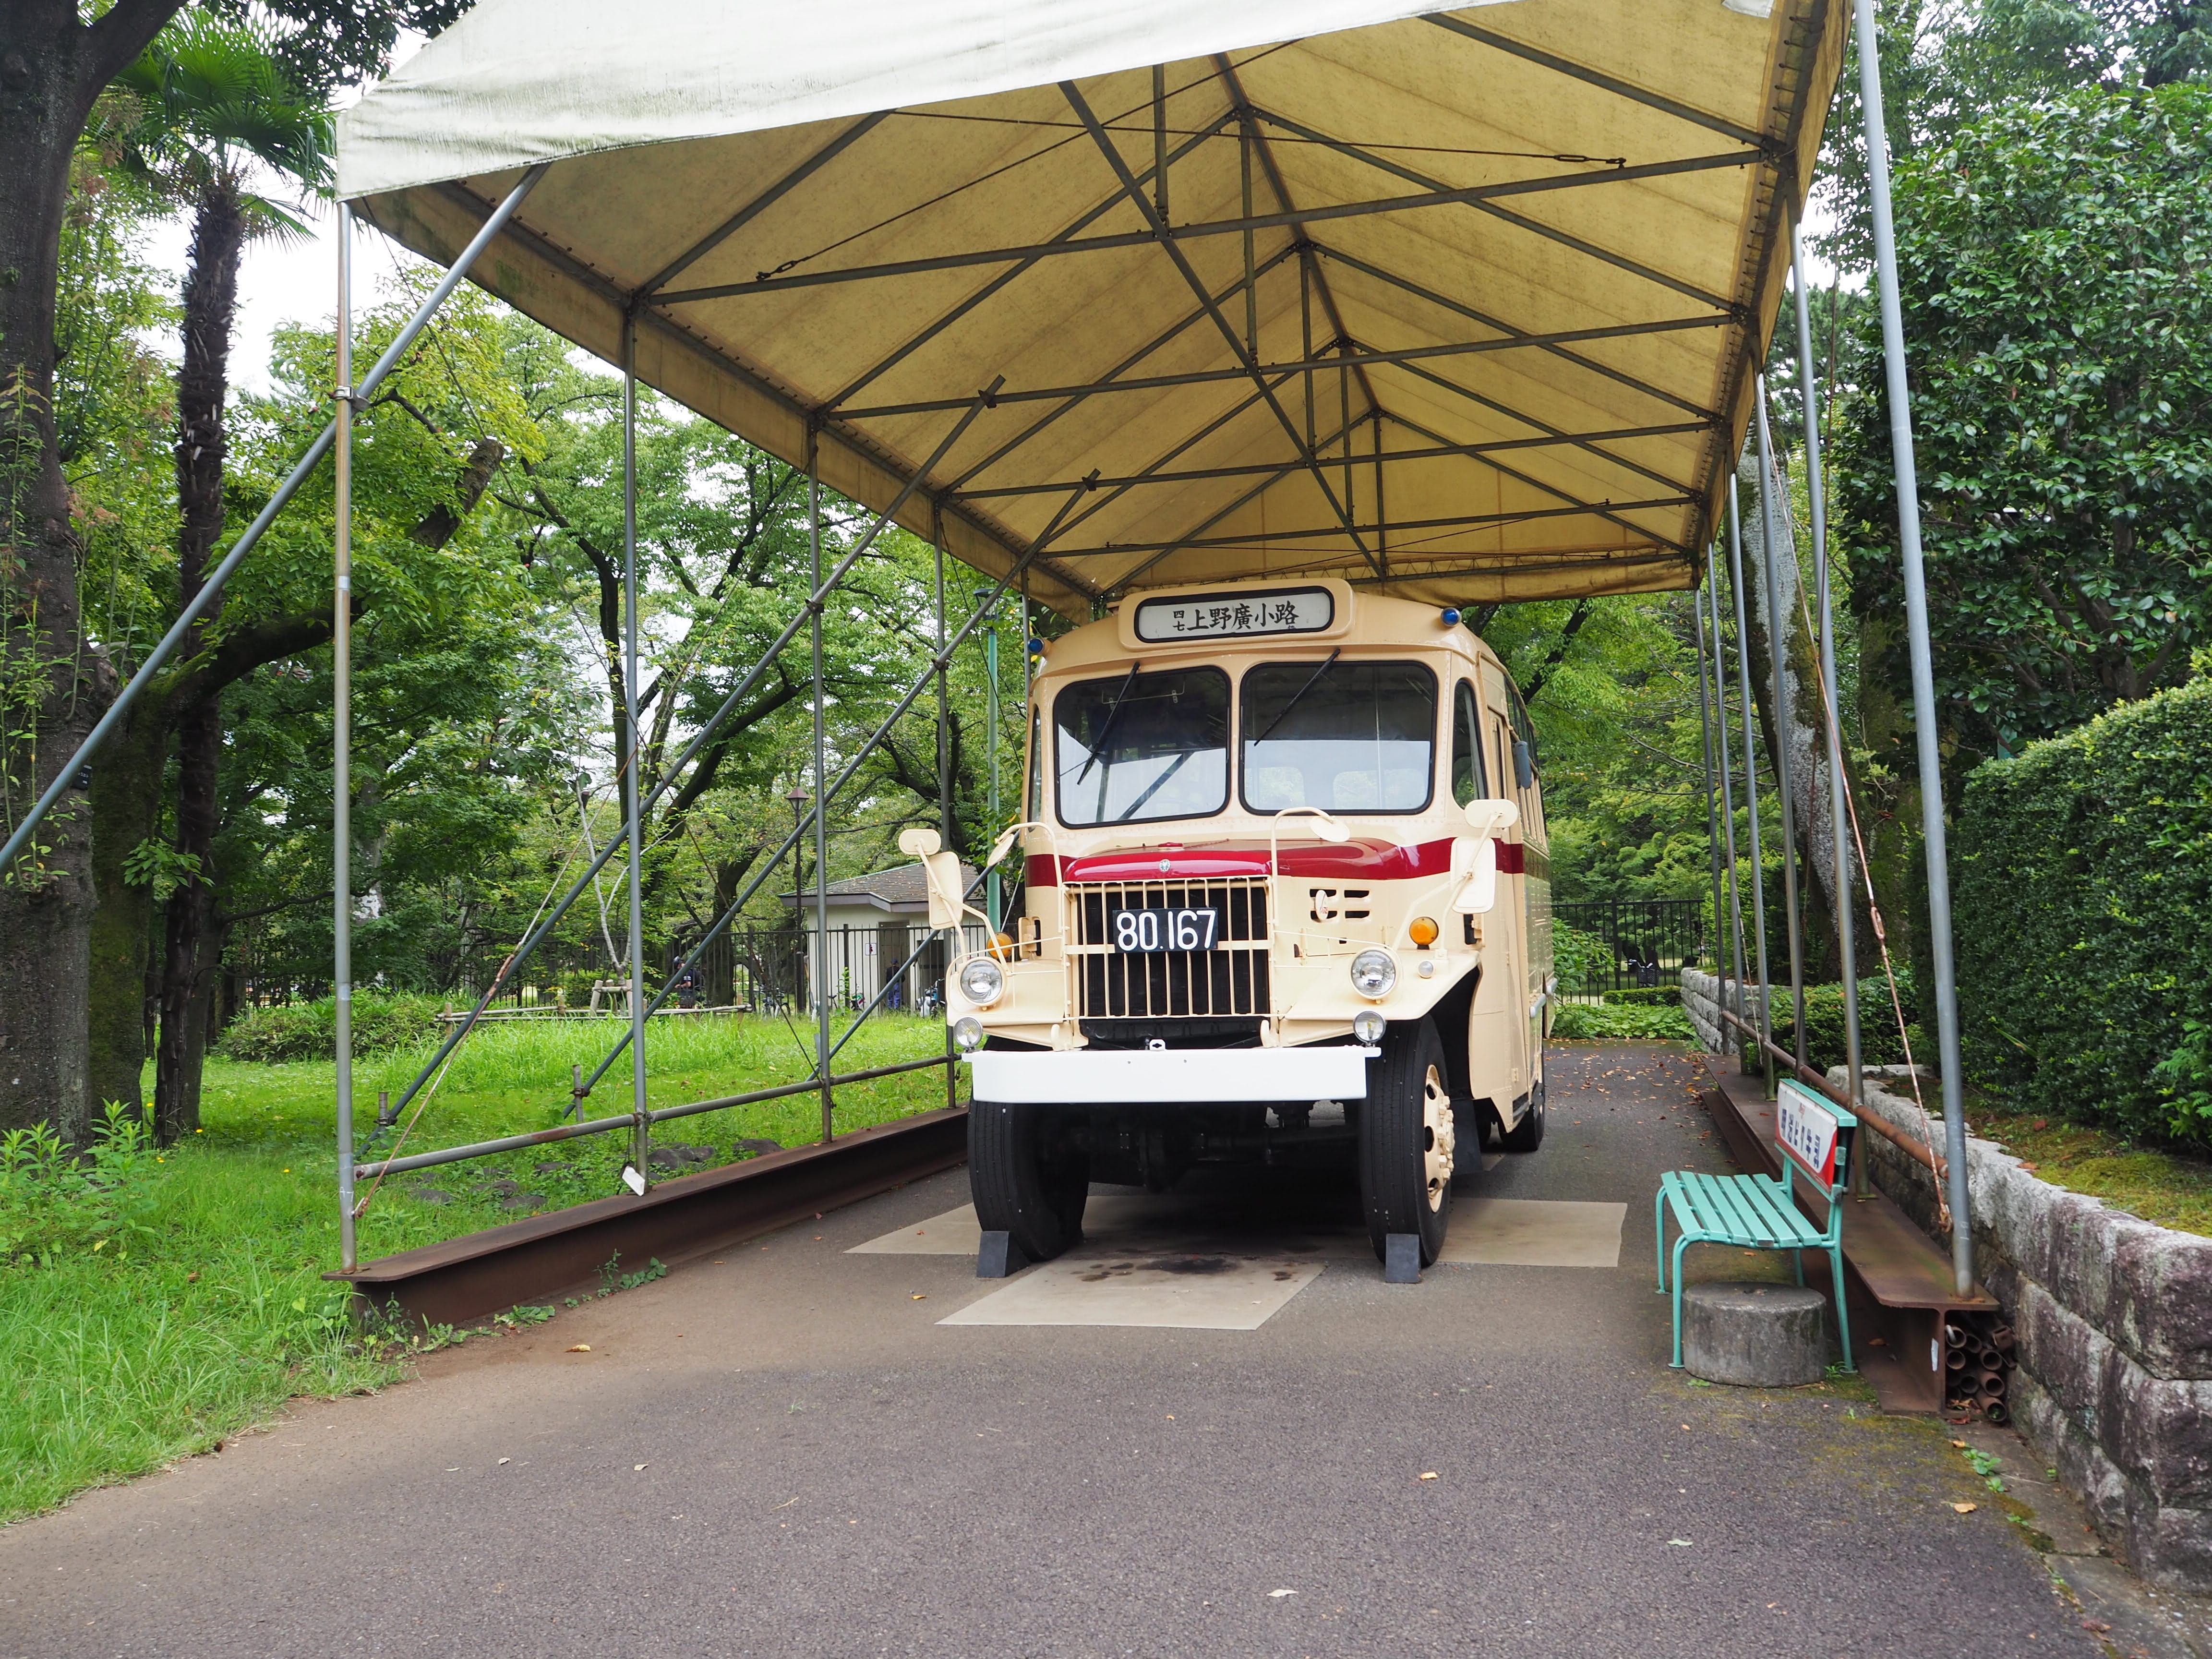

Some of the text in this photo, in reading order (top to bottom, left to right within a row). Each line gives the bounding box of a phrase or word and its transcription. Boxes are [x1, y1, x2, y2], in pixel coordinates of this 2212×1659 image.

[1173, 610, 1185, 631] 四七
[1187, 601, 1299, 630] 上野廣小路
[1117, 910, 1216, 951] 80.167
